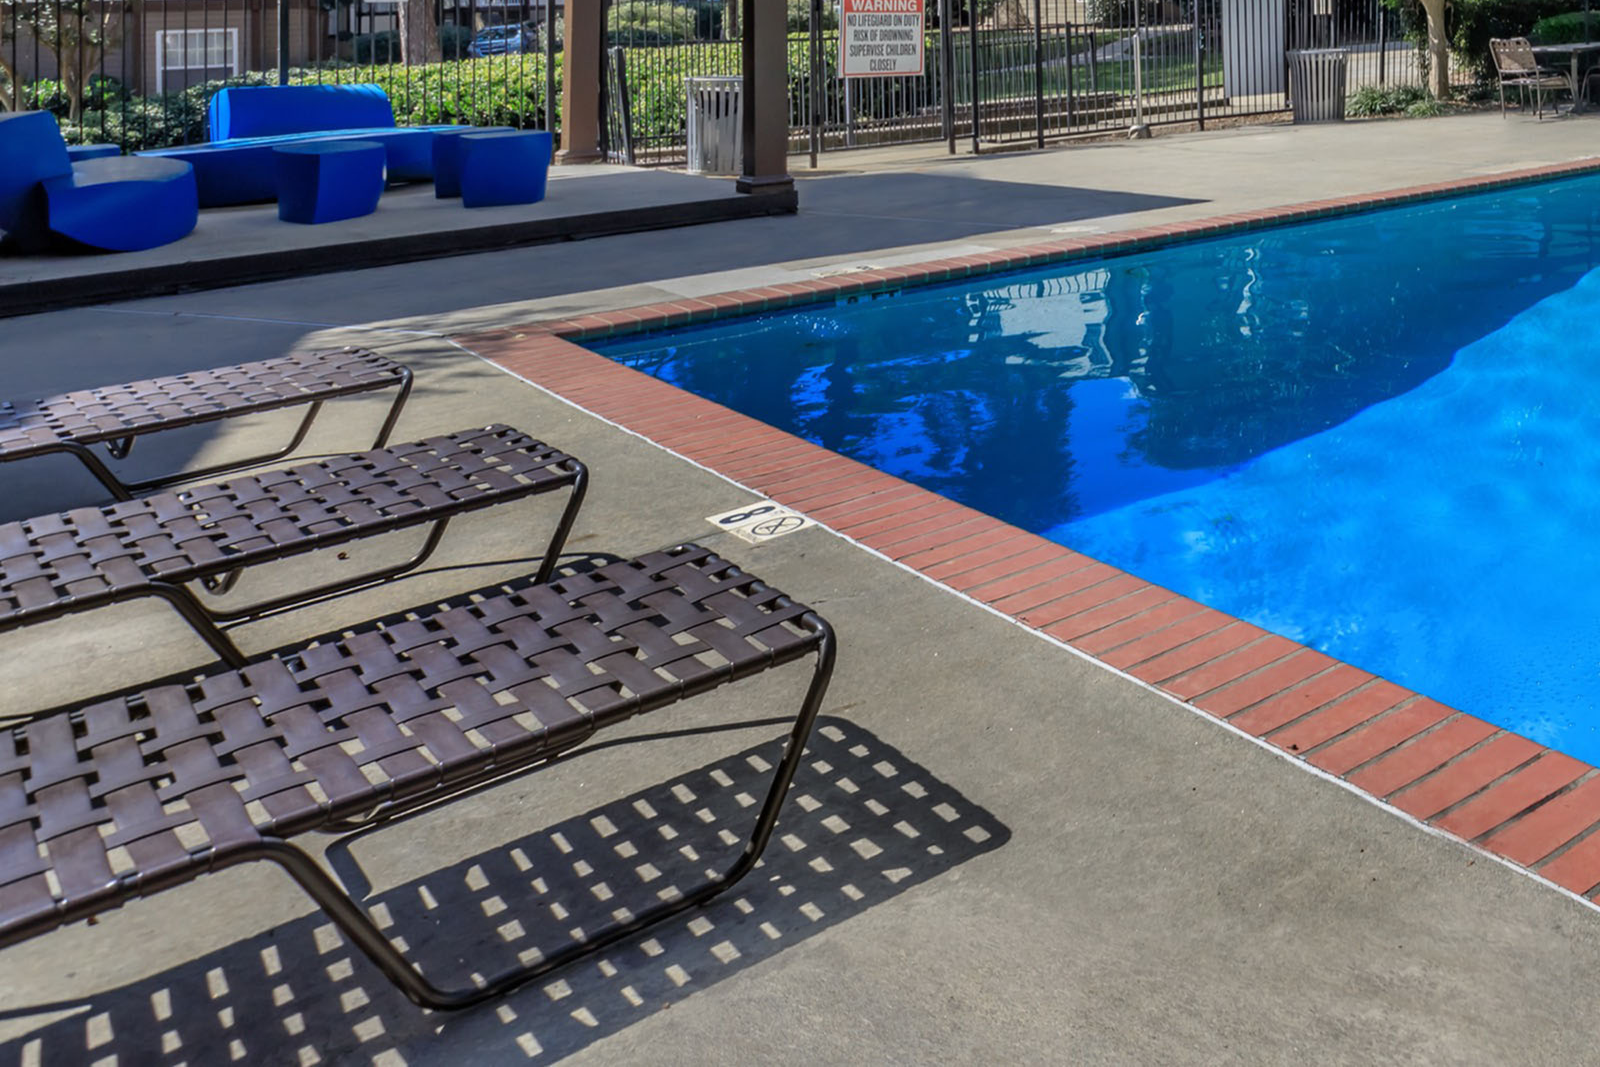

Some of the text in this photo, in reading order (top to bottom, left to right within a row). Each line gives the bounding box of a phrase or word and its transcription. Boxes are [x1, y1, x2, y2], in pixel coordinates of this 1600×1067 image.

[847, 14, 920, 27] NO LIFEGUARD ON DUTY
[853, 29, 914, 42] RISK OF DROWNING
[849, 43, 917, 57] SUPERVISE CHILDREN
[869, 58, 897, 71] CLOSELY
[718, 506, 776, 524] 8
